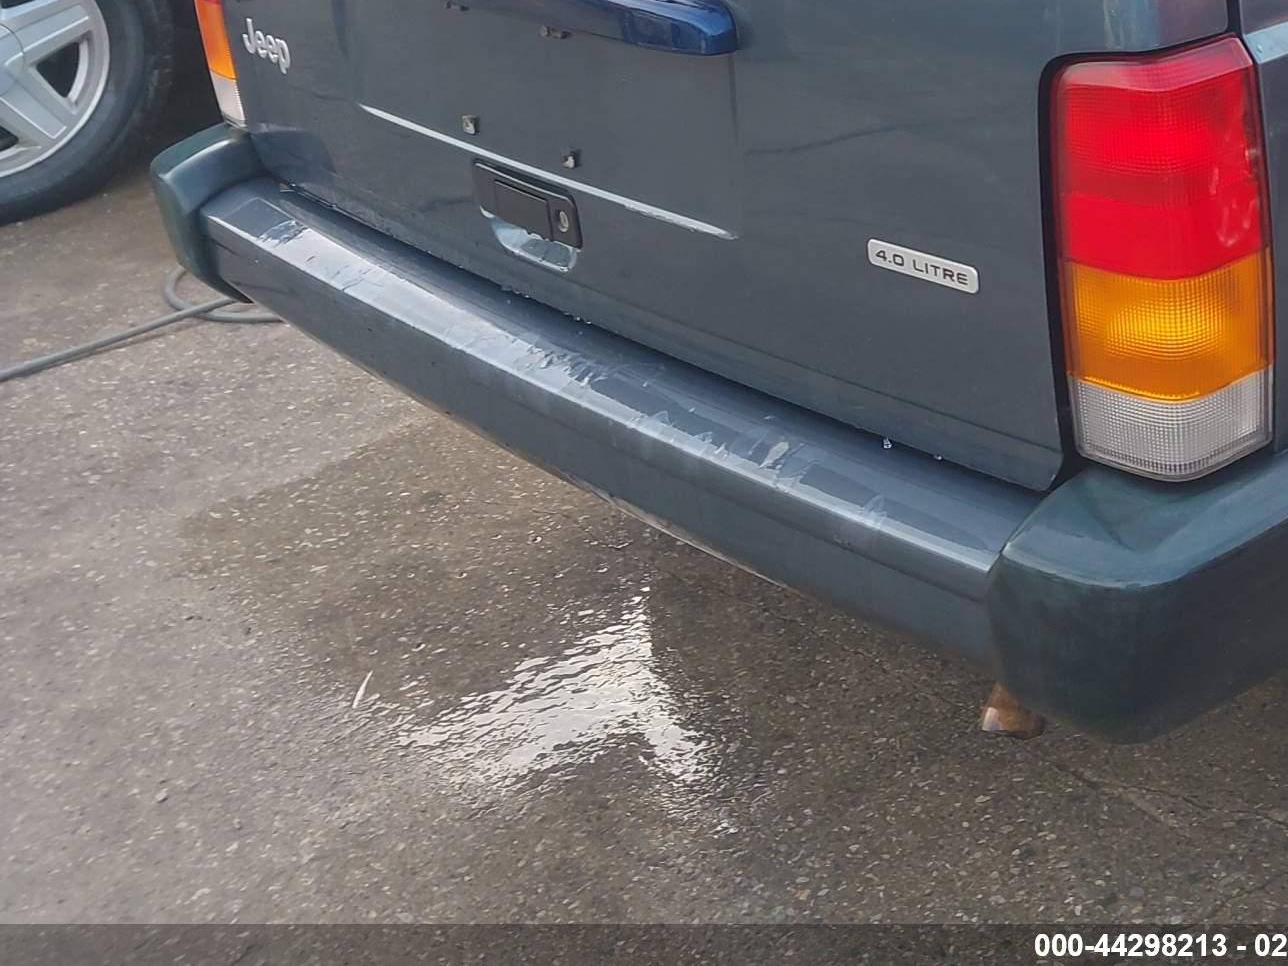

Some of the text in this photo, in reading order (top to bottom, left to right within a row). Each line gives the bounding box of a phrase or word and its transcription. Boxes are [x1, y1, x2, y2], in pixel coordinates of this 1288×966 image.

[242, 17, 290, 74] Jeep
[875, 250, 968, 286] 4.0 LITRE
